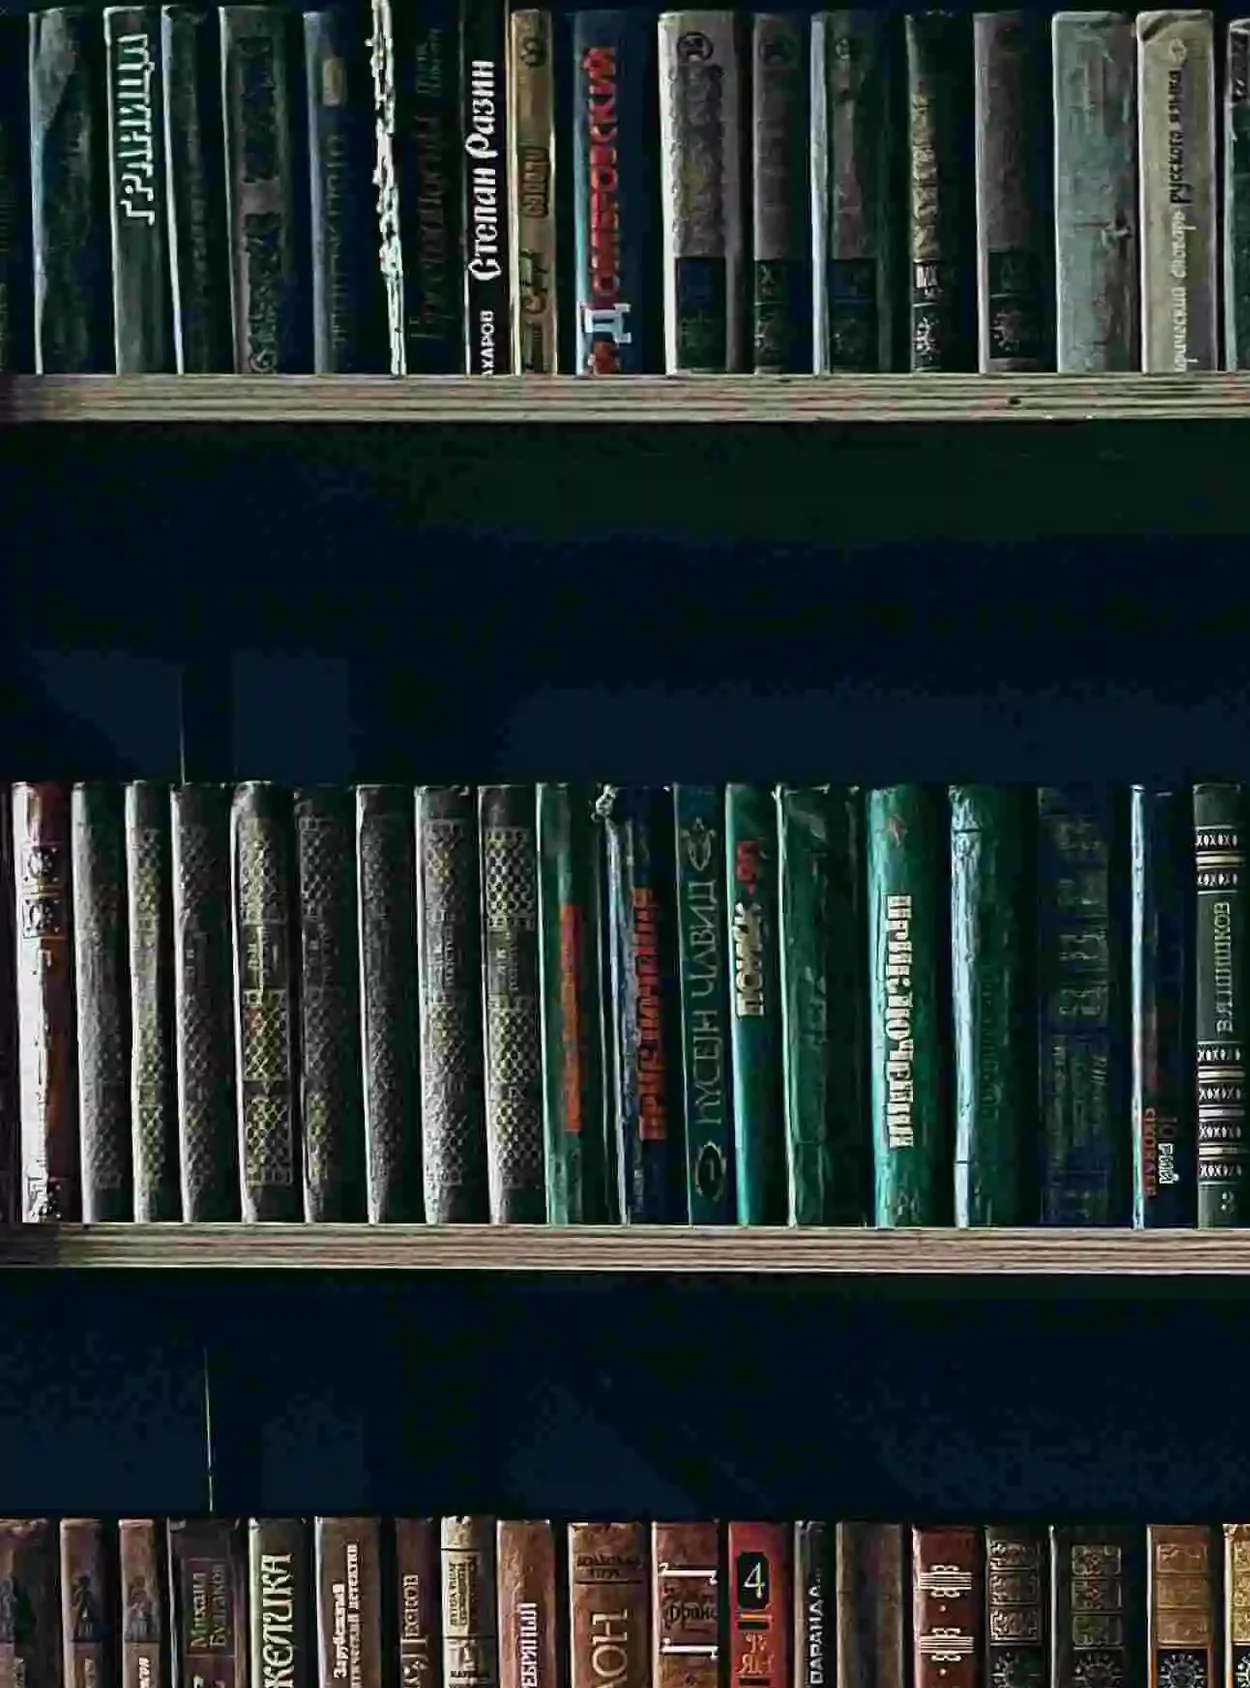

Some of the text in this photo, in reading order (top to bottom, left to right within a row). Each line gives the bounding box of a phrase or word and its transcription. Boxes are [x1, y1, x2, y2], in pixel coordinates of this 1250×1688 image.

[466, 60, 496, 281] Степан Разин
[733, 903, 765, 1016] ПОИСК
[333, 1583, 348, 1679] Зарубежный
[743, 1563, 768, 1598] 4
